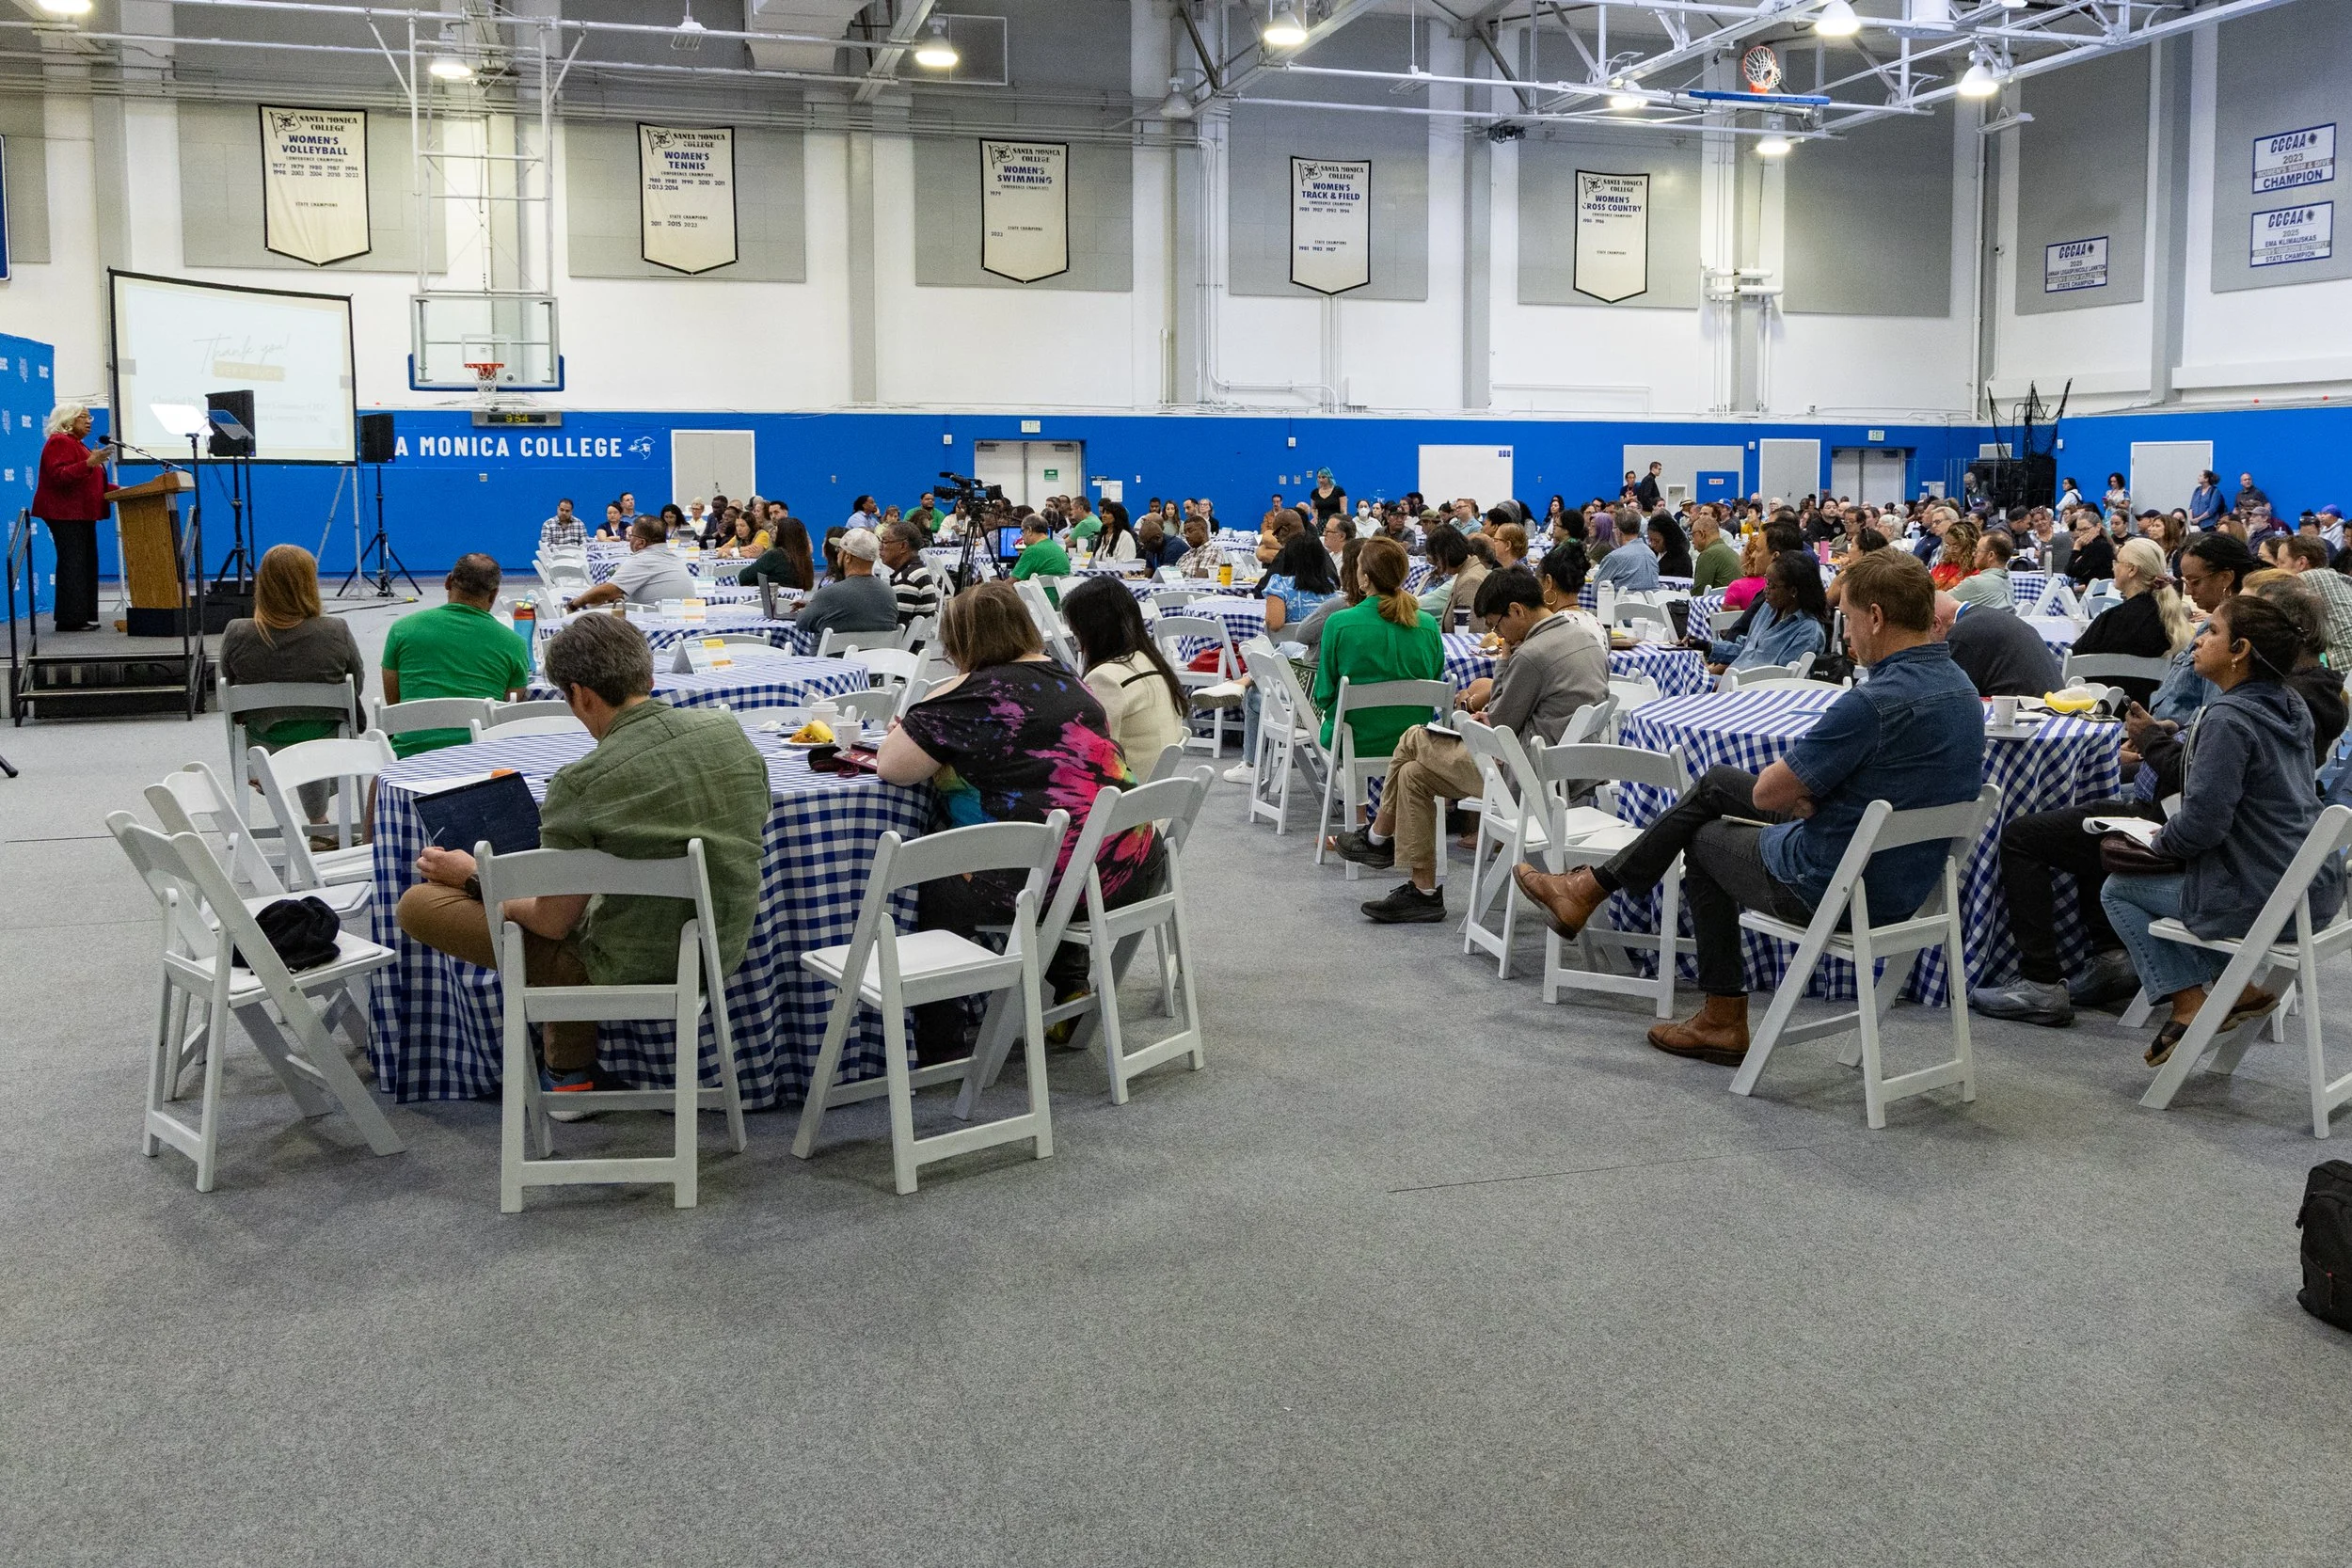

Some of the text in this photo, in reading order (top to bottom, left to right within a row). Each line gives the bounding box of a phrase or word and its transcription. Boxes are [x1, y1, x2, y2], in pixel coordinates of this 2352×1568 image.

[288, 135, 339, 145] WOMEN'S
[2270, 134, 2307, 153] CCCAA
[282, 145, 348, 155] VOLLEYBALL
[664, 150, 709, 161] WOMEN'S
[2282, 153, 2304, 165] 2023
[669, 161, 706, 169] TENNIS
[1003, 166, 1045, 175] WOMEN'S
[997, 174, 1053, 184] SWIMMING
[2264, 169, 2323, 188] CHAMPION
[1312, 182, 1351, 192] WOMEN'S
[1302, 191, 1328, 199] TRACK
[1595, 195, 1629, 204] WOMEN'S
[1608, 204, 1643, 213] COUNTRY
[2268, 210, 2304, 228] CCCAA
[2282, 229, 2299, 237] 2025
[2058, 244, 2086, 259] CCCAA
[2284, 251, 2315, 260] CHAMPION
[2072, 279, 2095, 288] CHAMPION
[193, 333, 254, 373] Thank
[420, 436, 510, 457] MONICA
[520, 437, 623, 458] COLLEGE
